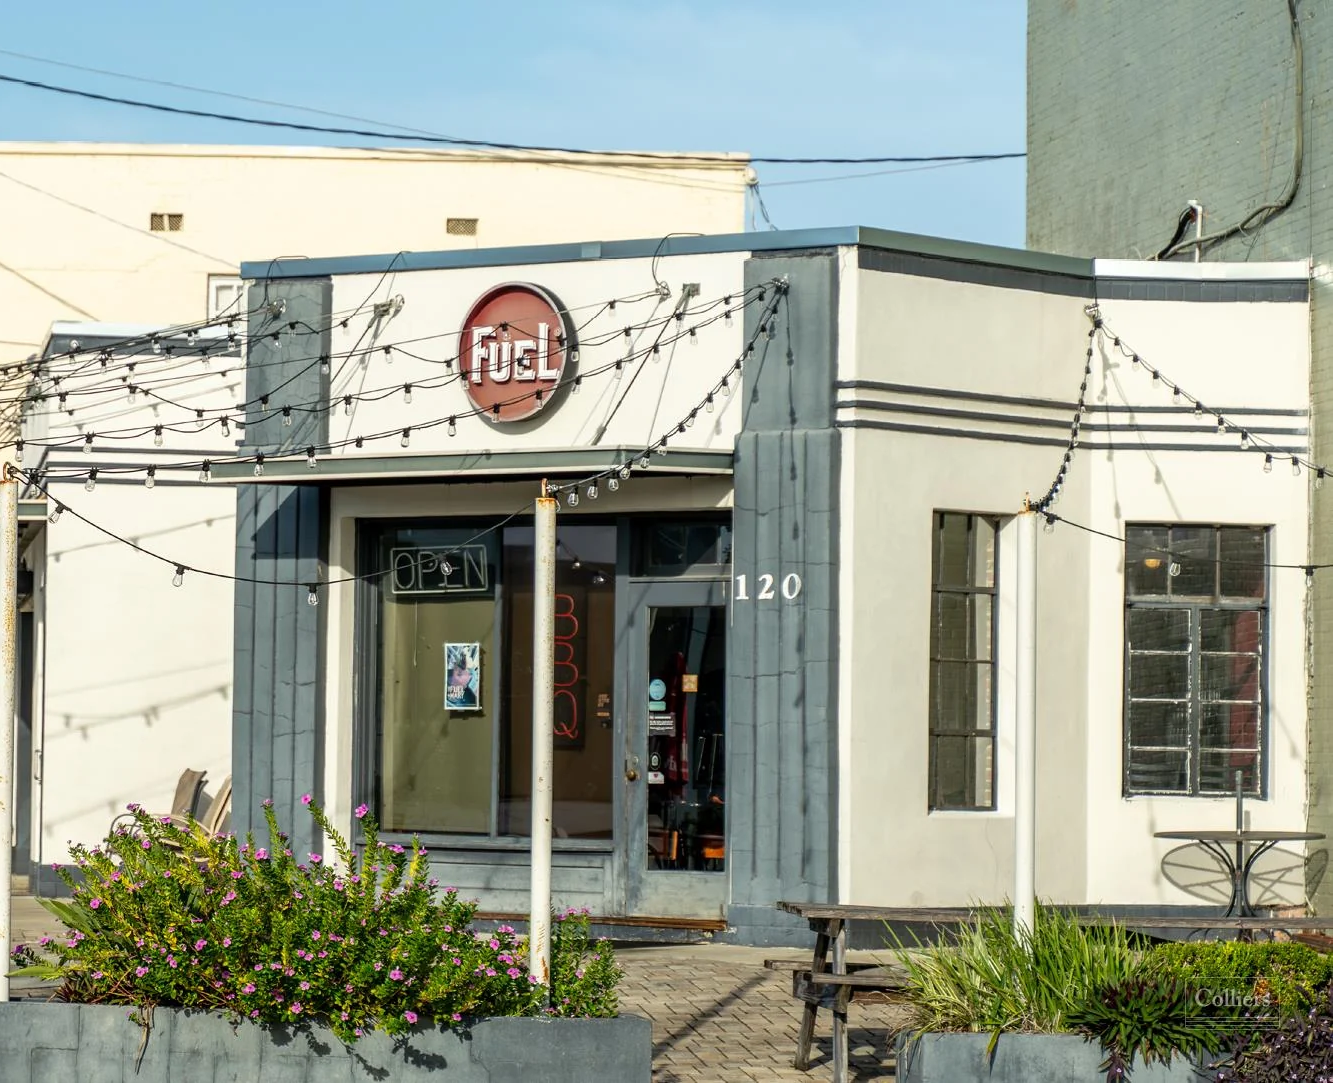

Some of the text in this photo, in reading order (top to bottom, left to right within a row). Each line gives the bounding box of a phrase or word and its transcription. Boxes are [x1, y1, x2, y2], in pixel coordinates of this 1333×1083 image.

[471, 322, 560, 384] FUEL
[394, 549, 485, 590] OPEN
[735, 572, 802, 600] 120
